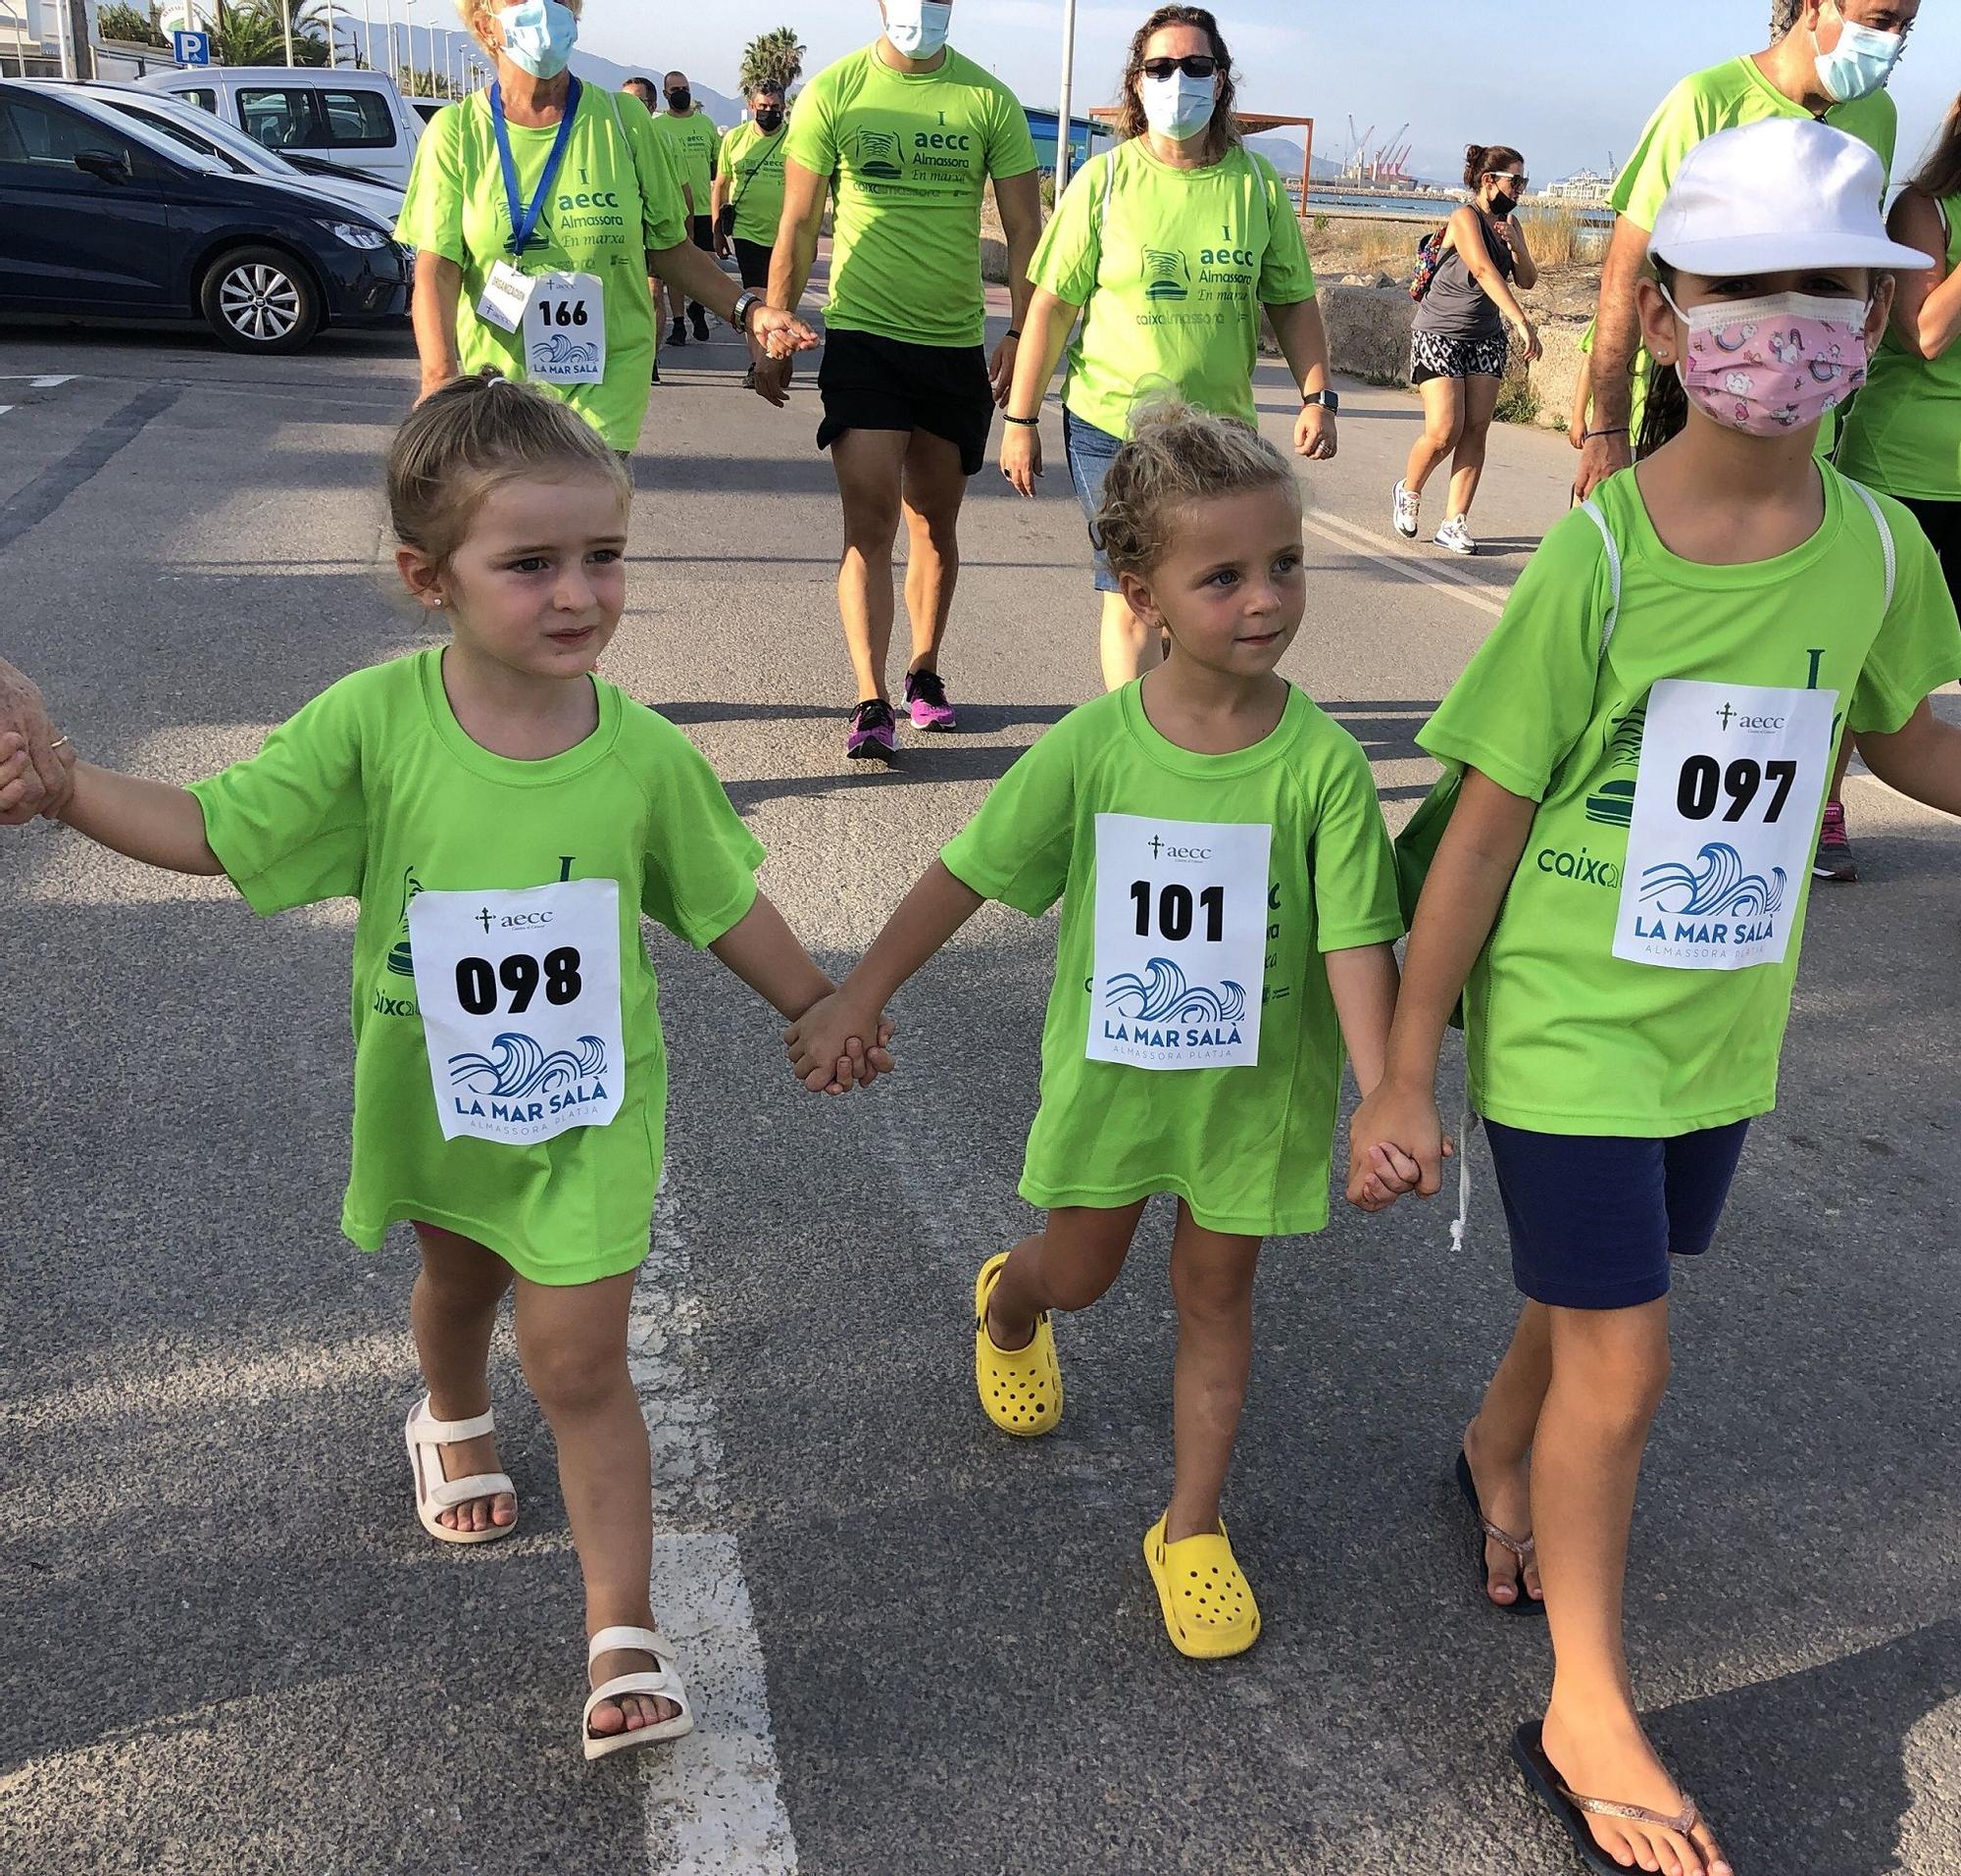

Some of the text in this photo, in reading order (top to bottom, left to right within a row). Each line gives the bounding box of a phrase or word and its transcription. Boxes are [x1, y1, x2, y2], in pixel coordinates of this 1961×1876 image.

[180, 34, 201, 60] P
[938, 111, 945, 126] I
[915, 132, 970, 151] aecc
[913, 152, 970, 169] Almassora
[578, 169, 588, 184] I
[558, 191, 619, 211] aecc
[561, 214, 624, 230] Almassora
[585, 233, 626, 246] marxa
[1222, 225, 1232, 241] I
[1200, 249, 1253, 267] aecc
[1198, 270, 1252, 284] Almassora
[538, 300, 588, 327] 166
[534, 364, 546, 373] LA
[549, 365, 571, 374] MAR
[1739, 716, 1785, 729] aecc
[1677, 755, 1797, 823] 097
[1167, 846, 1213, 859] aecc
[1131, 881, 1224, 941] 101
[501, 912, 554, 928] aecc
[1634, 916, 1666, 940] LA
[1675, 922, 1726, 943] MAR
[1645, 944, 1727, 958] ALMASSORA
[455, 946, 581, 1015] 098
[1104, 1020, 1242, 1047] LA MAR SALÀ
[1113, 1045, 1232, 1060] ALMASSORA PLATJA
[455, 1076, 608, 1123] LA MAR SALÀ
[470, 1106, 599, 1136] ALMASSORA PLATJA
